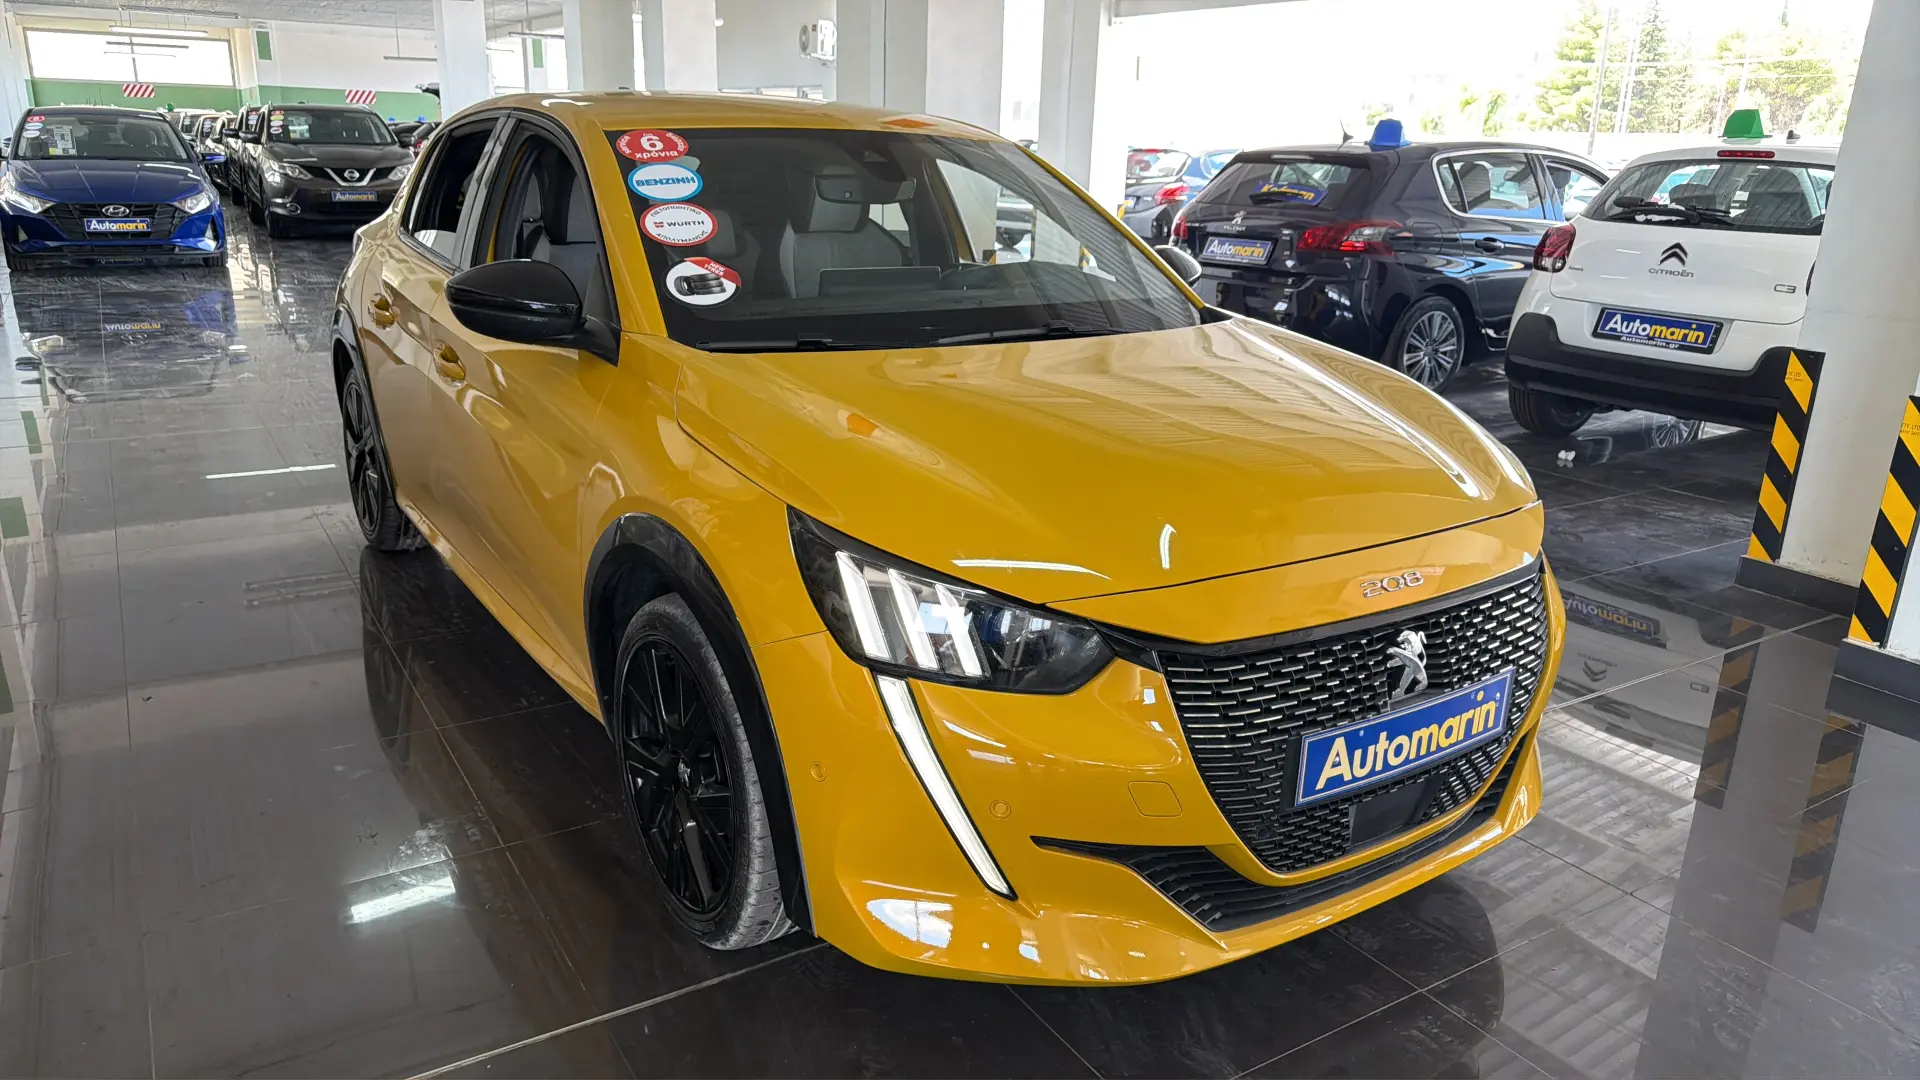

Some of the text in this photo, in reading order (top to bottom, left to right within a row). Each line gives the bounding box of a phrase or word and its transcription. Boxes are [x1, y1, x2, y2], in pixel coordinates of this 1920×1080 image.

[640, 135, 664, 151] 6
[635, 150, 679, 159] χρόνια
[635, 176, 697, 187] ΒΕΝΖΙΝΗ
[336, 191, 375, 201] Automarin
[90, 219, 147, 230] Automarin
[1207, 239, 1264, 257] Automarin
[704, 264, 725, 276] TYRES
[709, 262, 726, 272] NEW
[1774, 284, 1797, 294] C3
[1604, 313, 1705, 344] Automarin
[1360, 571, 1424, 598] 208
[1315, 690, 1497, 791] Automarin
